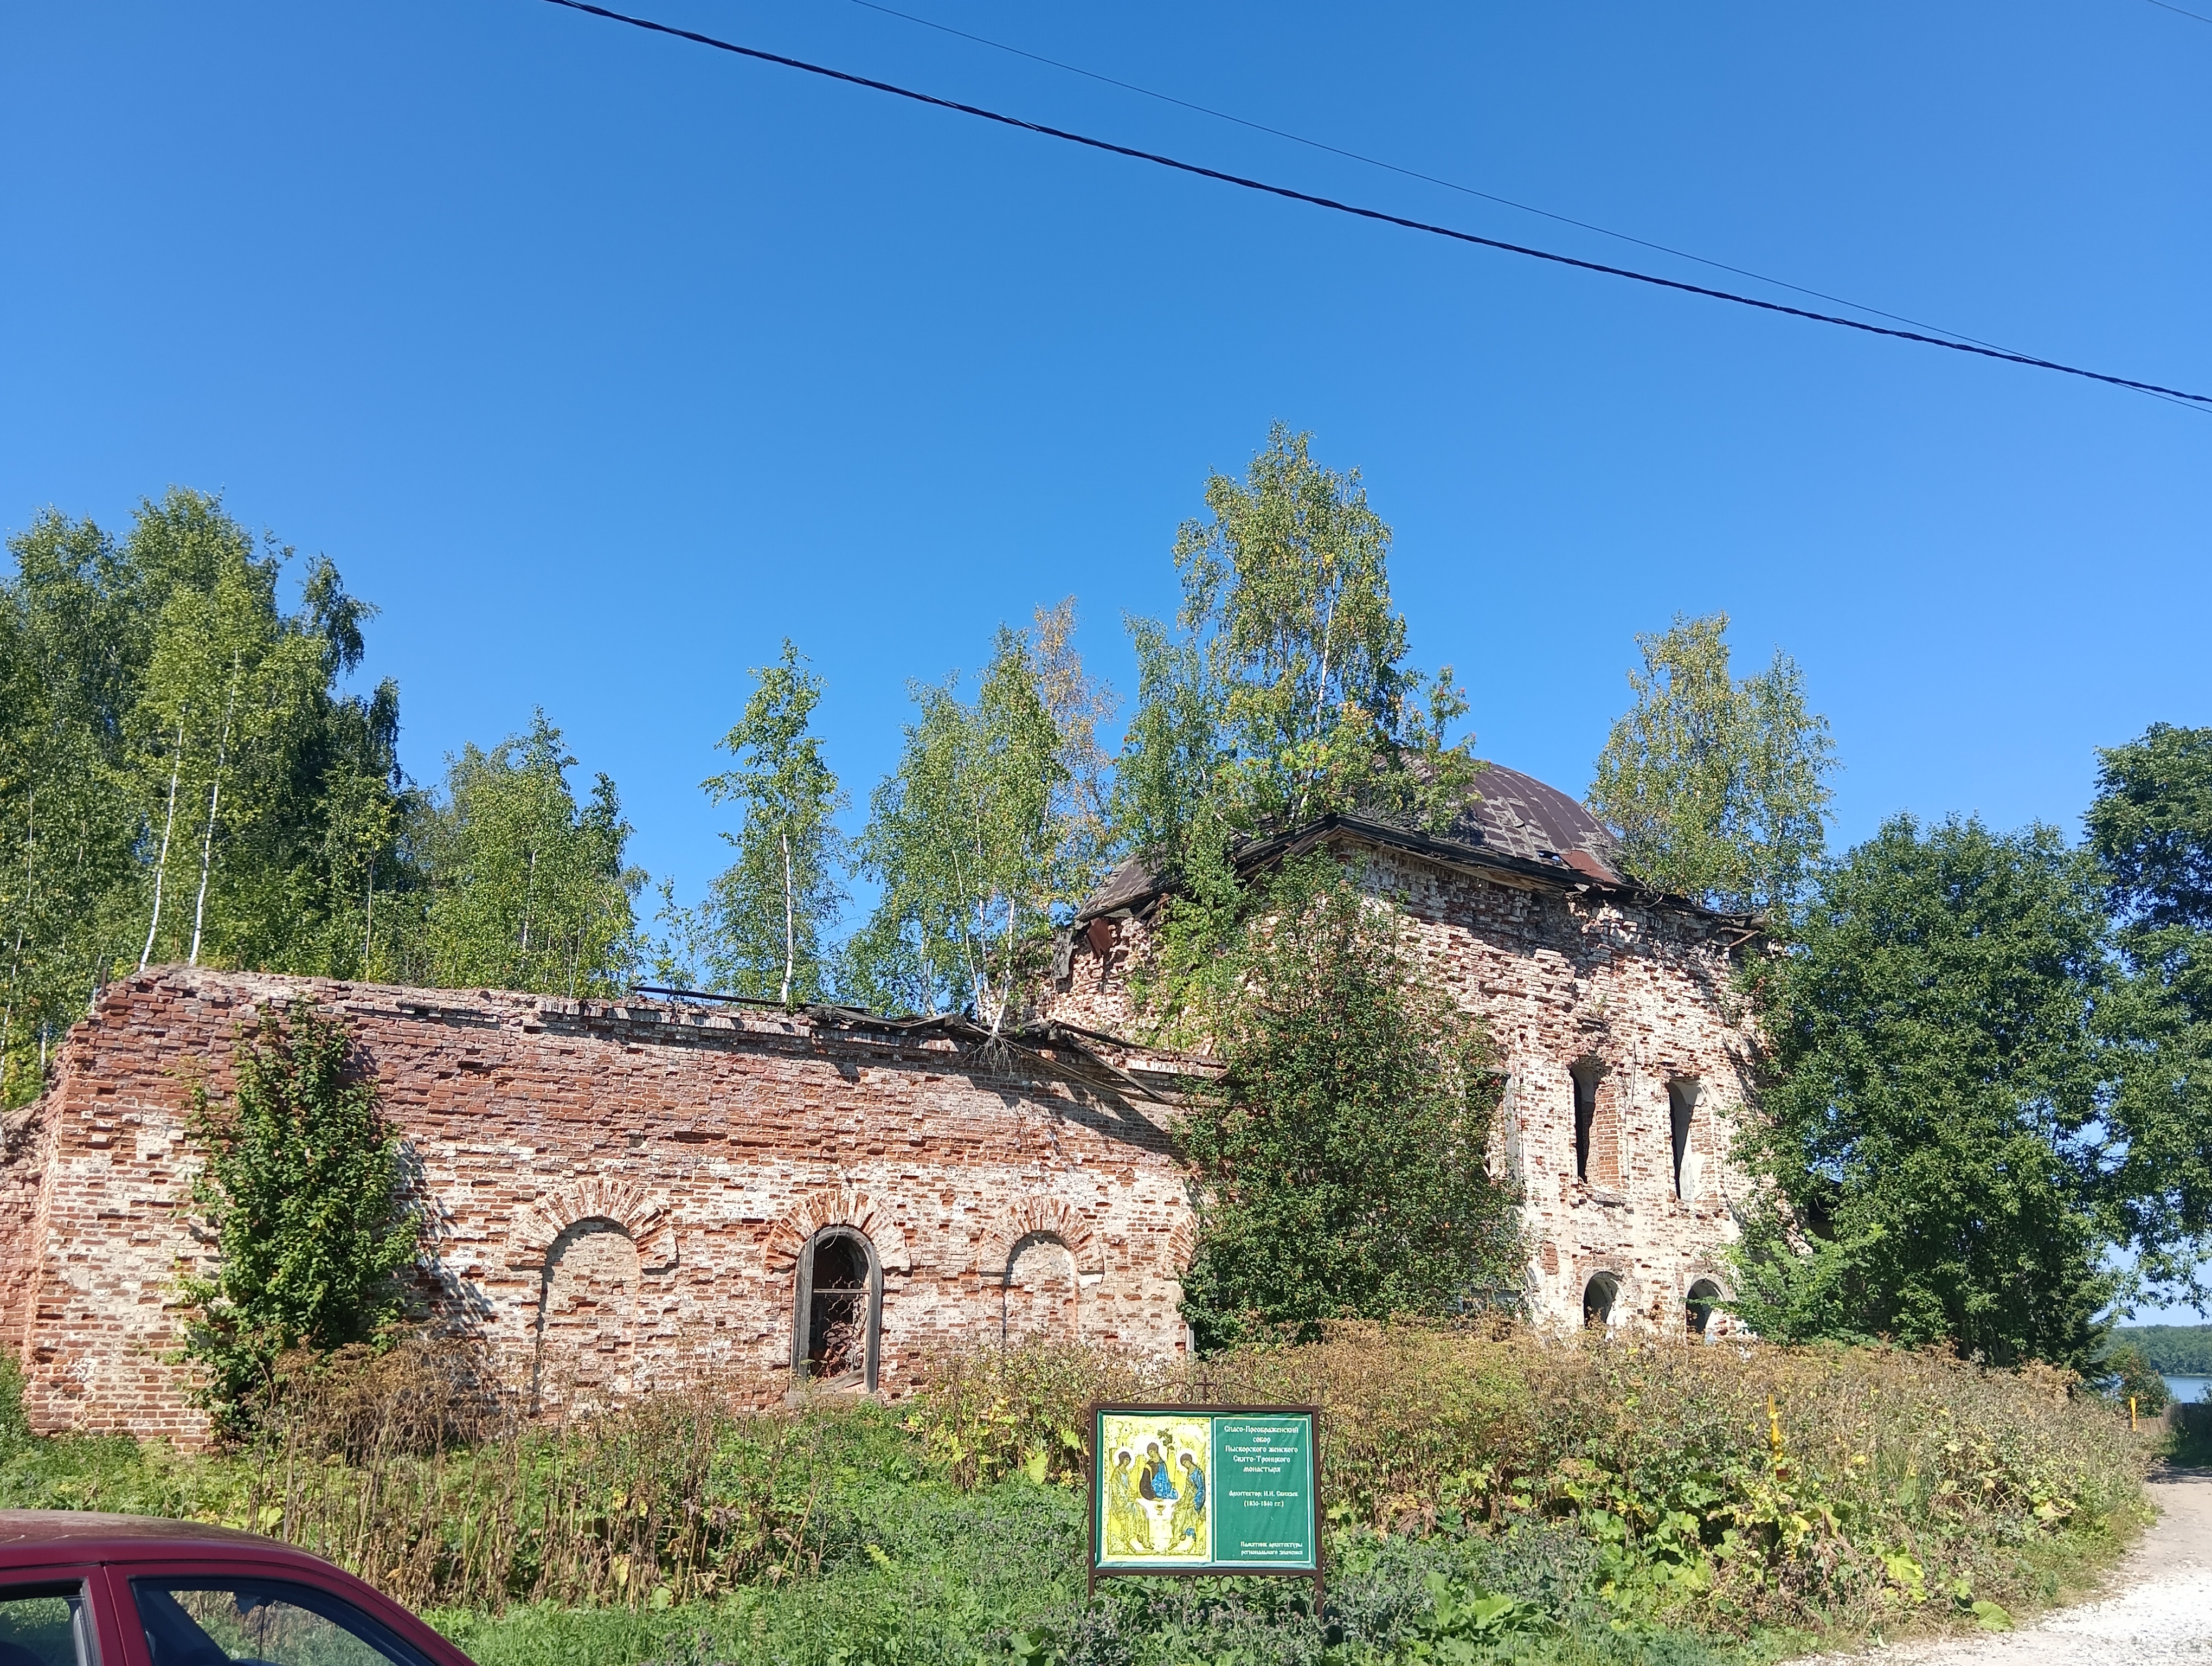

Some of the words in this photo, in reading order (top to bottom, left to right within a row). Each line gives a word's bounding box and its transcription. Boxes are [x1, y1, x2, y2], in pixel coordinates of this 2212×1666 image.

[1224, 1425, 1299, 1434] Спасо-Преображенский
[1225, 1445, 1266, 1454] Пыскорского
[1233, 1454, 1291, 1464] Свято-Троицкого
